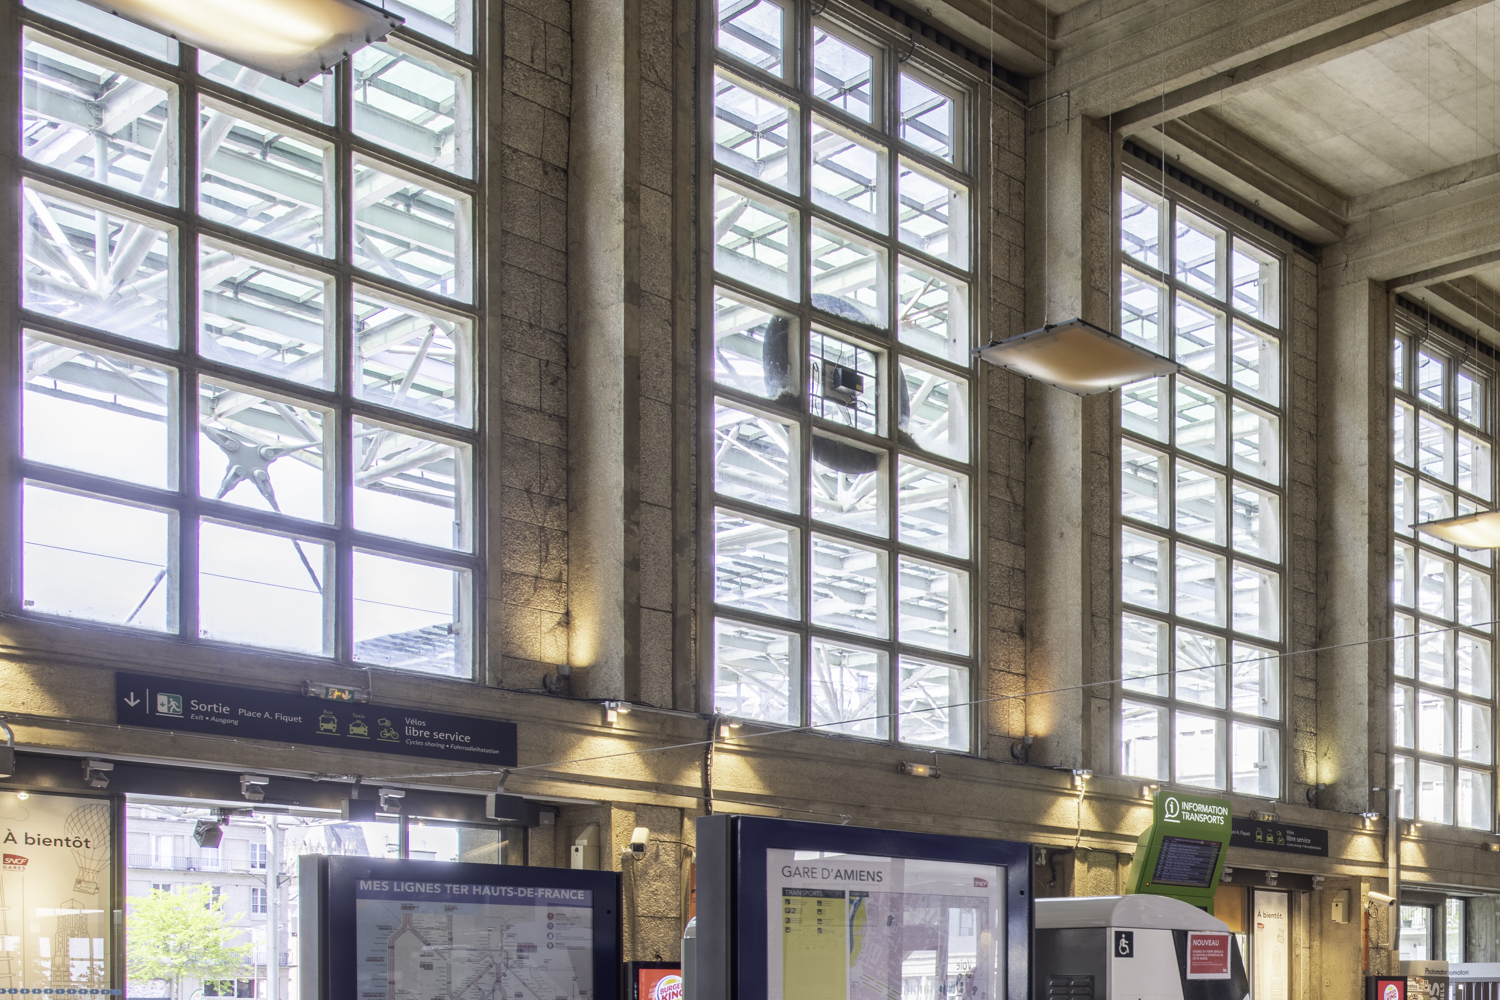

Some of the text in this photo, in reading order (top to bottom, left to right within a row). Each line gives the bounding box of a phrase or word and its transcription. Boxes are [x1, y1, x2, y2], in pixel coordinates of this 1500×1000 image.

[190, 699, 303, 725] Sortie Place A. Fiquet
[190, 713, 240, 726] Exit Ausgang
[404, 716, 427, 727] Vélos
[405, 725, 472, 743] libre service
[405, 738, 446, 750] Cycles sharing
[1181, 801, 1229, 816] INFORMATION
[1181, 811, 1225, 826] TRANSPORTS
[3, 828, 92, 849] À bientôt
[4, 857, 27, 865] SNCF
[781, 865, 883, 882] GARE D'AMIENS
[359, 879, 585, 900] MES LIGNES TER HAUTS-DE-FRANCE
[785, 889, 824, 897] TRANSPORTS
[1192, 939, 1220, 947] NOUVEAU
